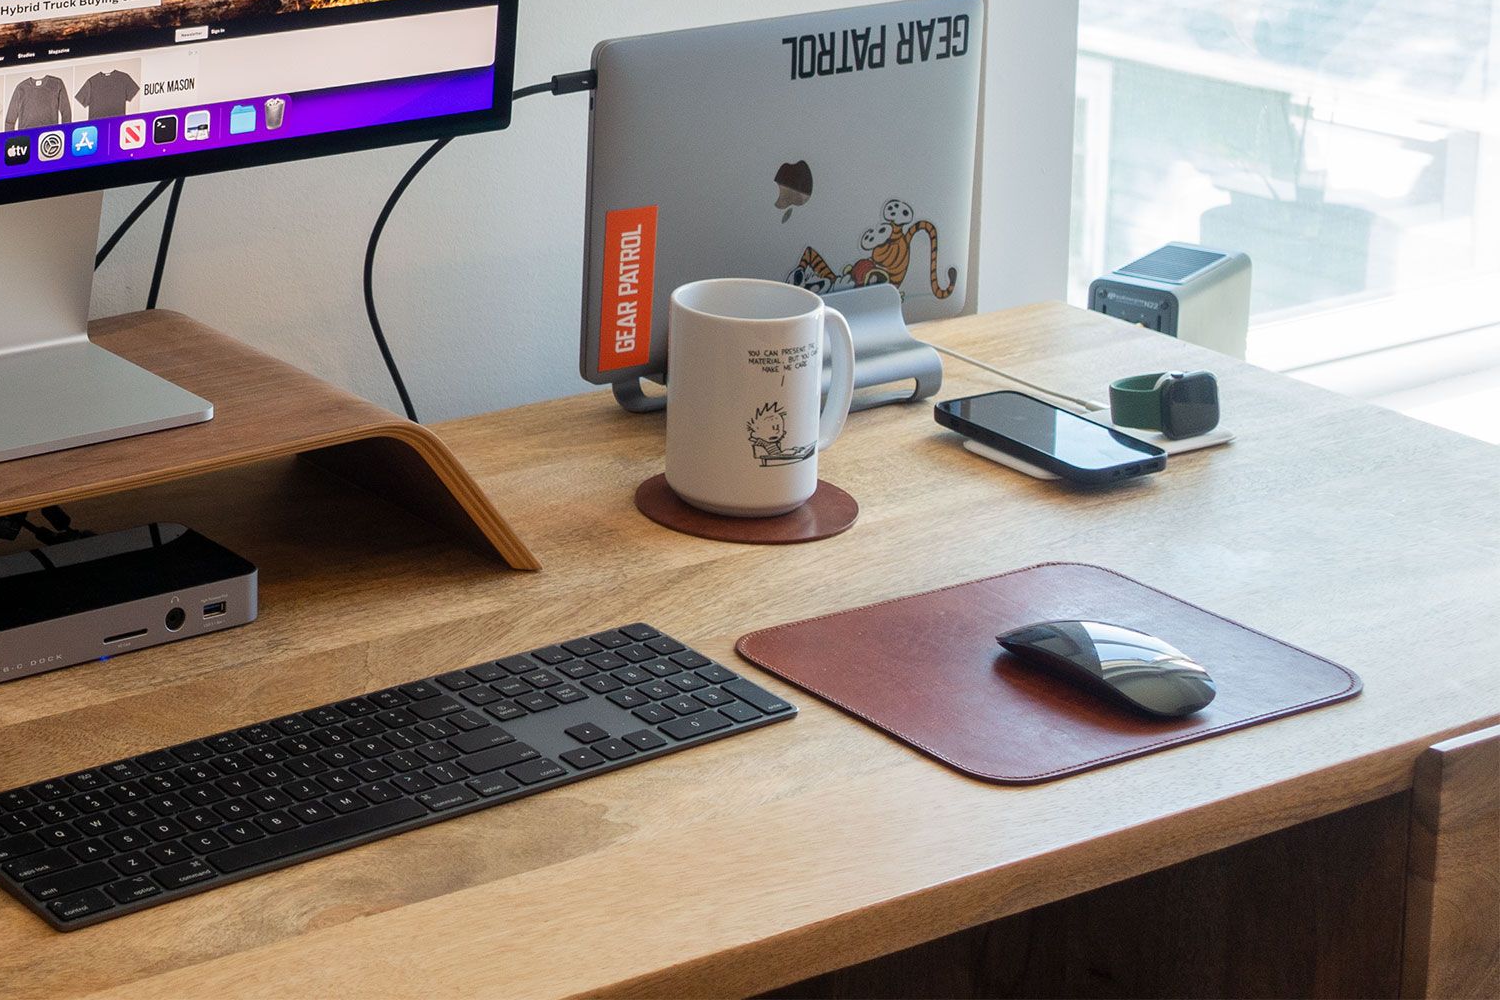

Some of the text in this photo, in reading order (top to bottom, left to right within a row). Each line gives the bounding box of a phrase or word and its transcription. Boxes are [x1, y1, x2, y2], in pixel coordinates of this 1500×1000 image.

[0, 1, 41, 18] Hybrid
[48, 47, 70, 56] Magazine
[781, 14, 970, 80] GEAR PATROL
[144, 77, 195, 96] BUCK MASON
[614, 223, 642, 355] GEAR PATROL
[764, 349, 779, 357] CAN
[781, 345, 806, 355] PRESENT
[788, 354, 799, 363] BUT
[762, 365, 780, 373] MAKE
[30, 654, 63, 666] DOCK
